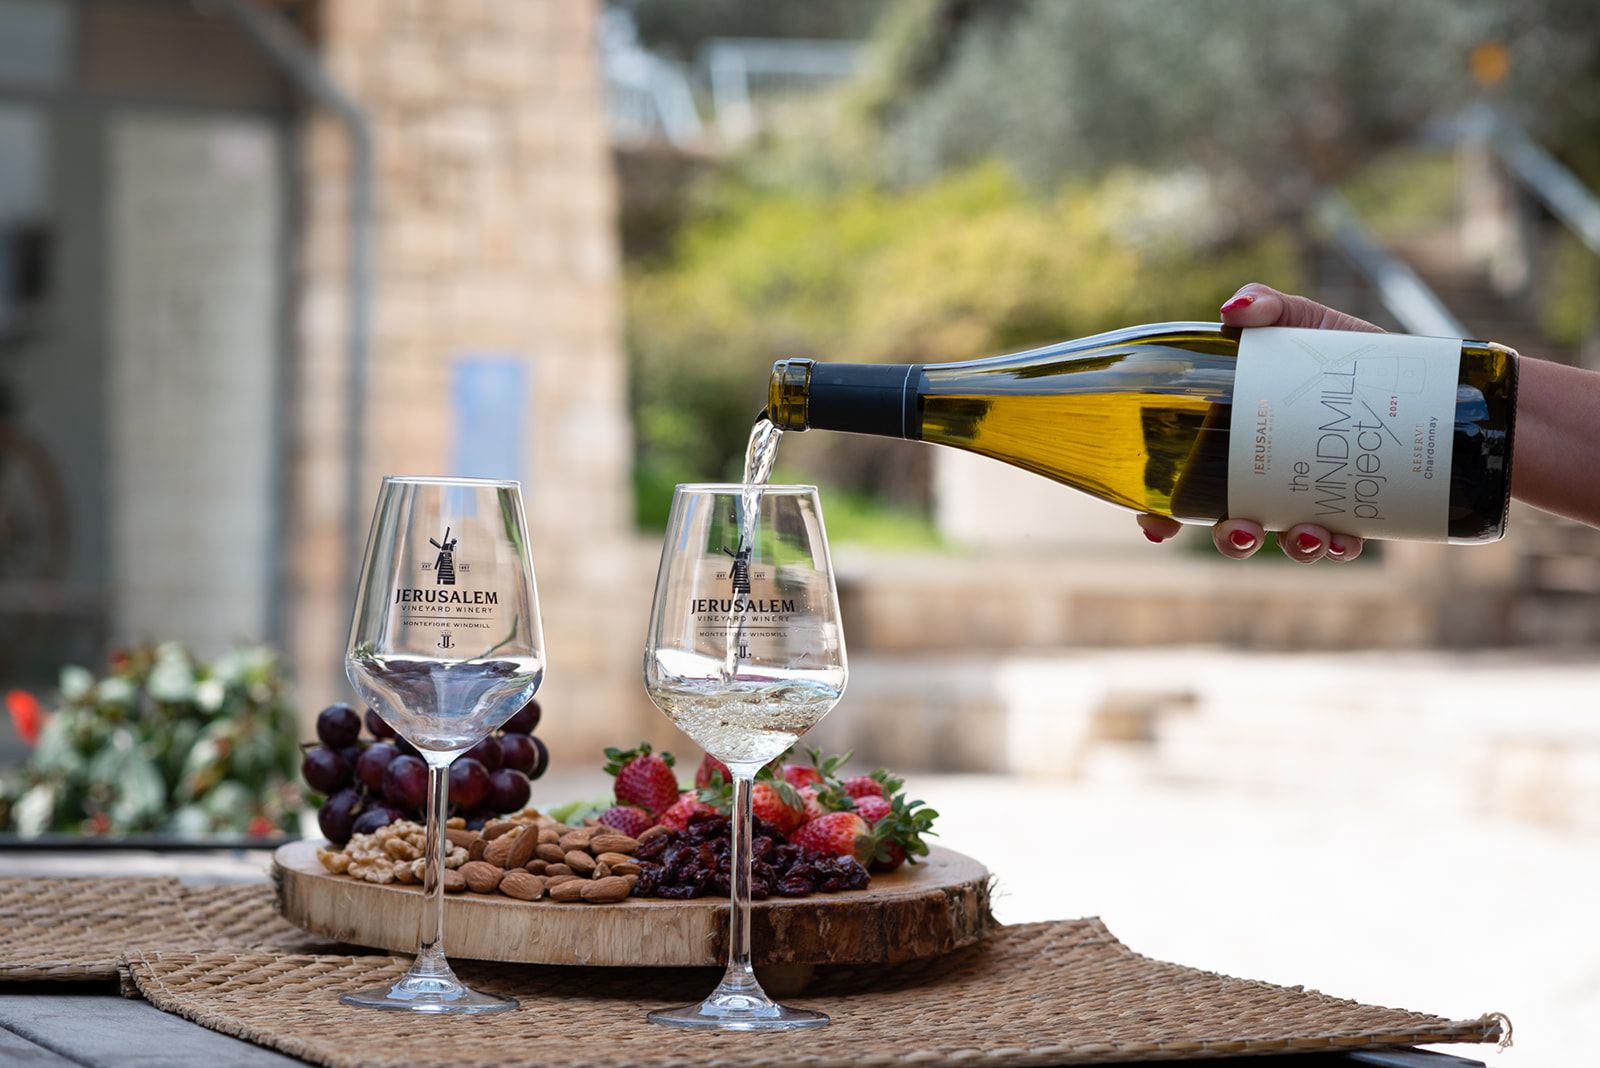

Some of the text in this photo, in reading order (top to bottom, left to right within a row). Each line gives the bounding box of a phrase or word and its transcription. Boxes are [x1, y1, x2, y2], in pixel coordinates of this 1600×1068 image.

[1389, 395, 1399, 418] 2021
[1314, 360, 1358, 516] WINDMILL
[1424, 415, 1439, 480] Chardonnay
[1289, 461, 1310, 493] the
[1347, 420, 1388, 521] project
[395, 589, 498, 604] JERUSALEM
[691, 599, 796, 614] JERUSALEM
